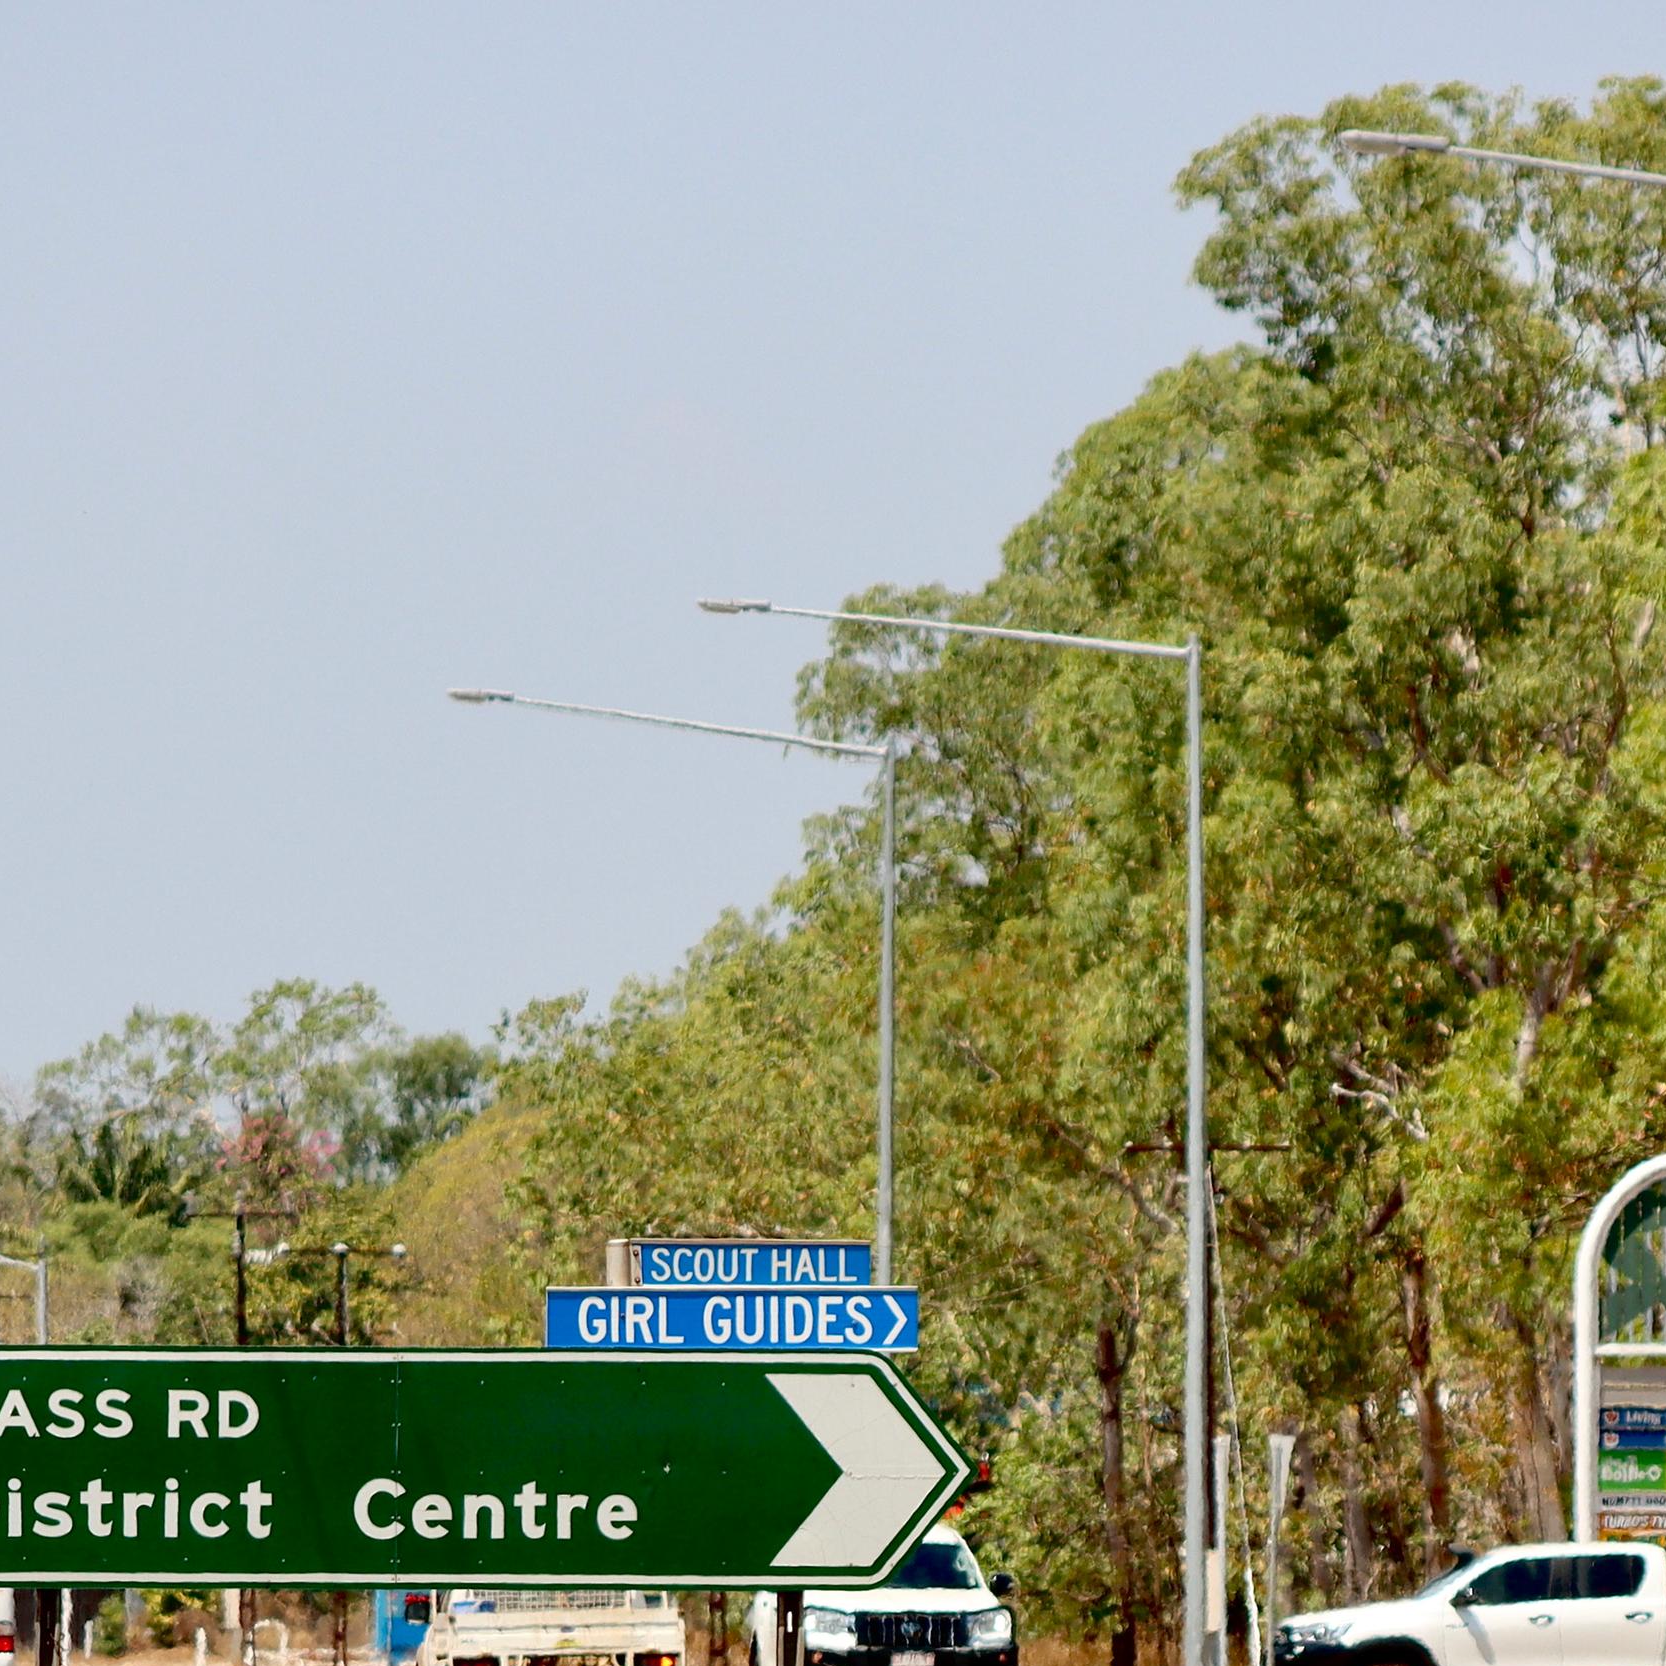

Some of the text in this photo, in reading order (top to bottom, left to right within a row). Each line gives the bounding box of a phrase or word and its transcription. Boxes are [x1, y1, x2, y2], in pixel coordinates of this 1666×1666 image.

[651, 1248, 858, 1282] SCOUT HALL
[578, 1295, 873, 1344] GIRL GUIDES
[167, 1389, 260, 1439] RD
[1626, 1411, 1661, 1425] Living
[353, 1477, 638, 1540] Centre
